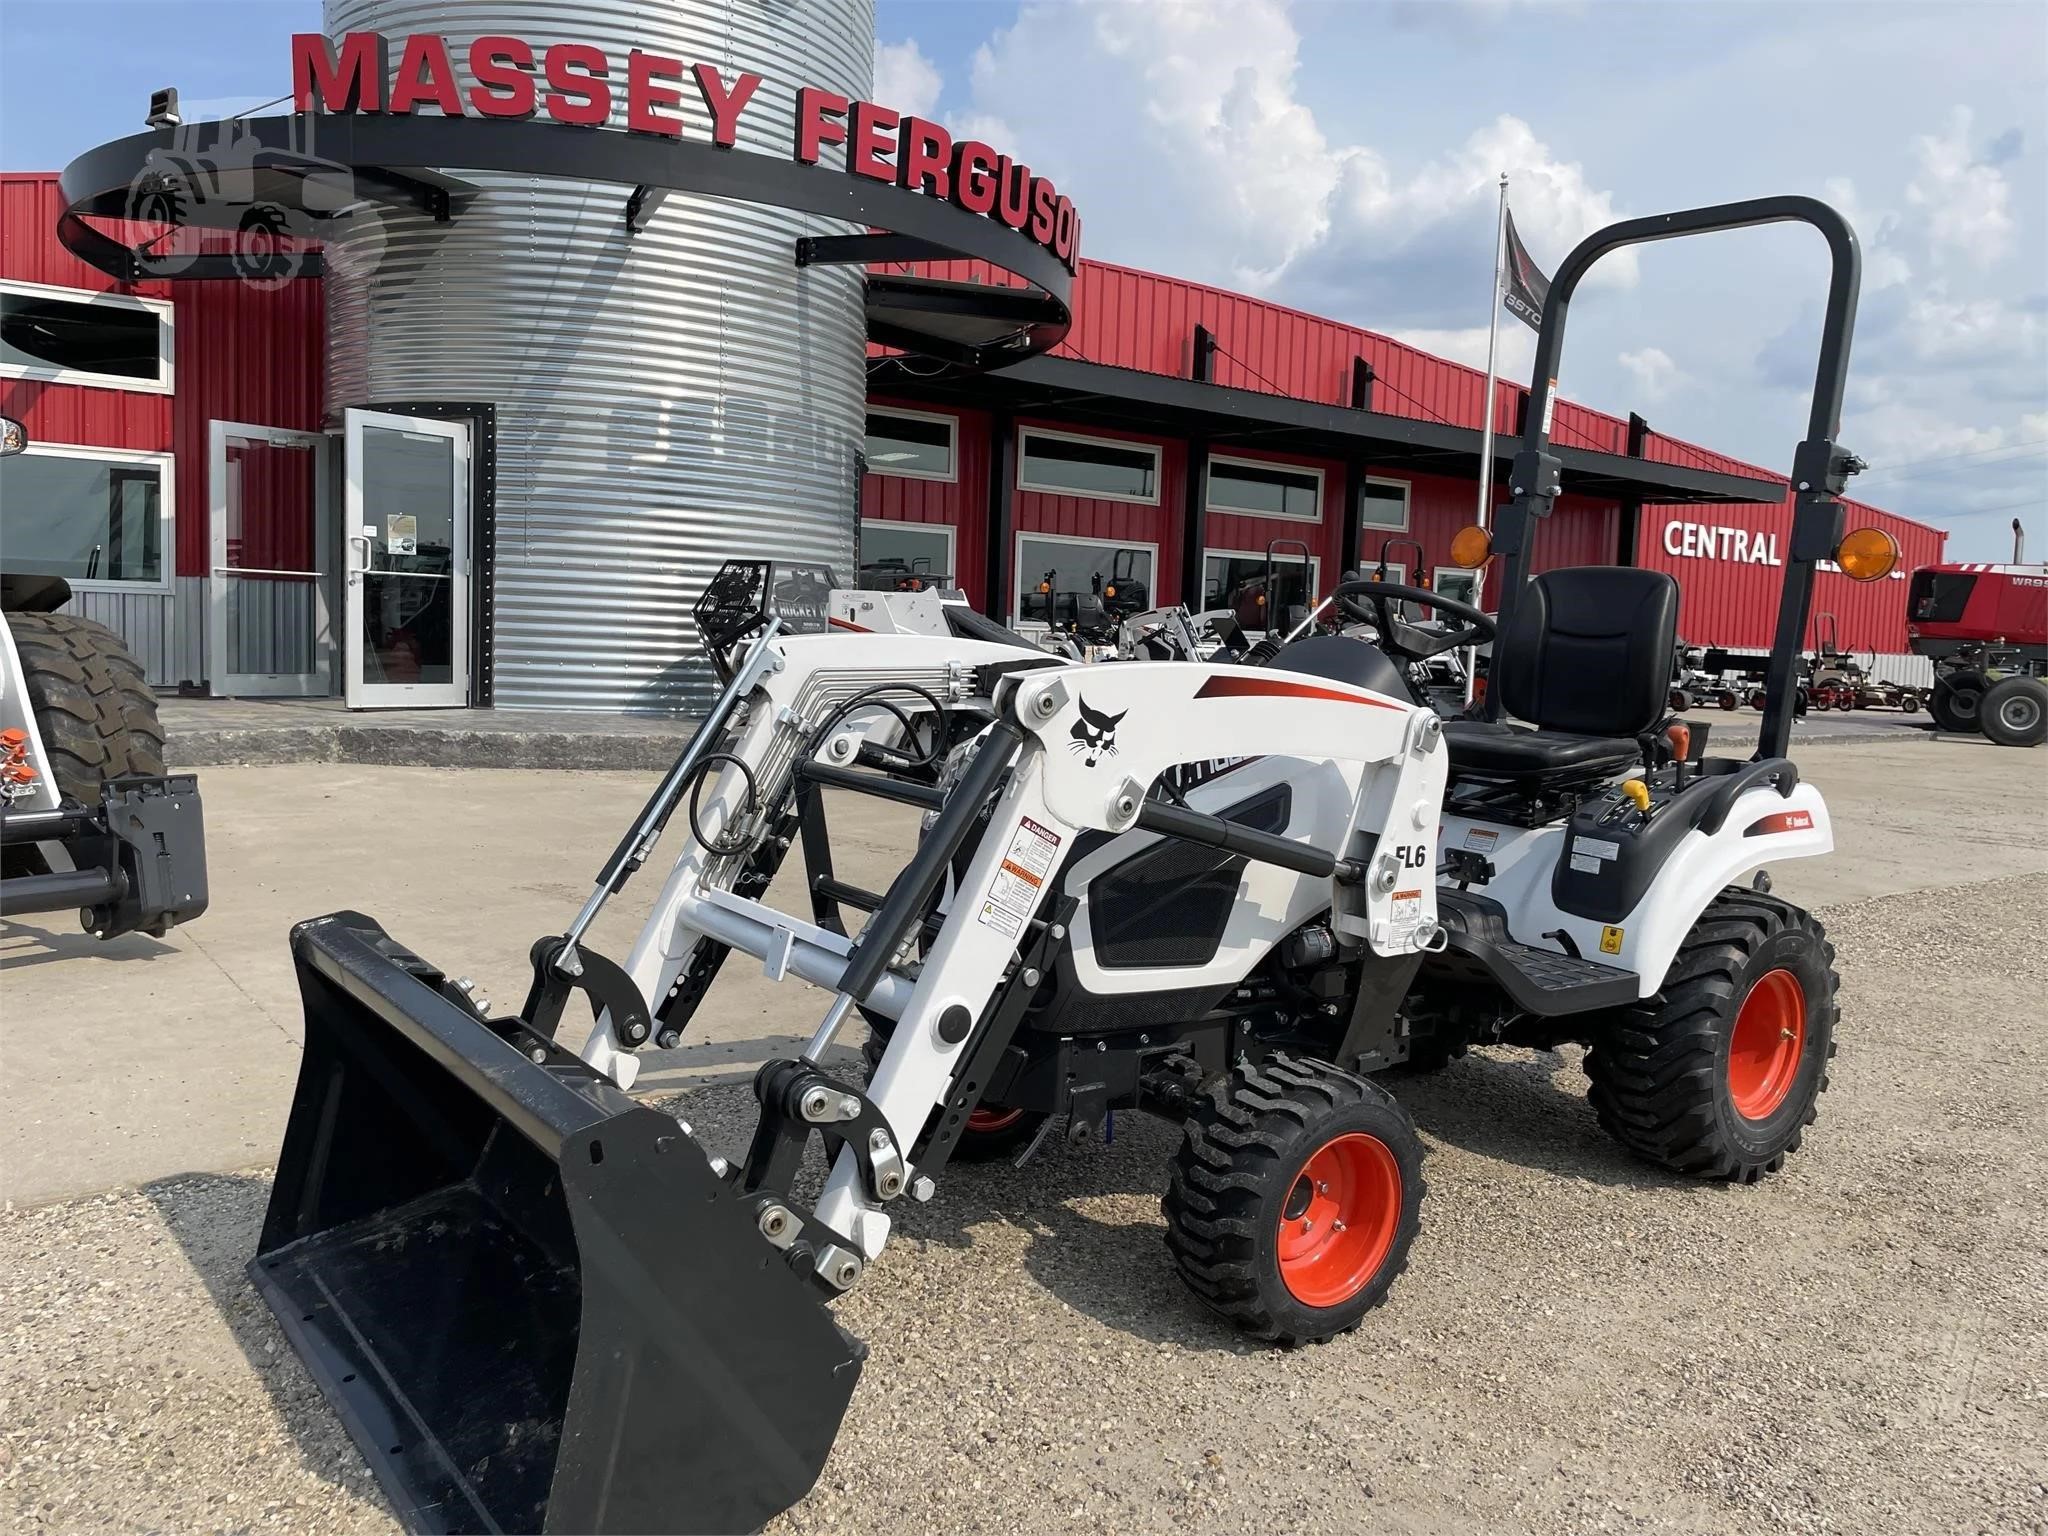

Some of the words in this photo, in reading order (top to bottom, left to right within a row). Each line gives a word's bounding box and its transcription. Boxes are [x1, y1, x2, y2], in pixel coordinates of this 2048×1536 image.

[292, 32, 762, 147] MASSEY
[798, 87, 1082, 276] FERGUSON
[1664, 520, 1781, 566] CENTRAL
[1031, 824, 1057, 843] DANGER
[1396, 845, 1426, 868] FL6
[1010, 866, 1038, 885] WARNING
